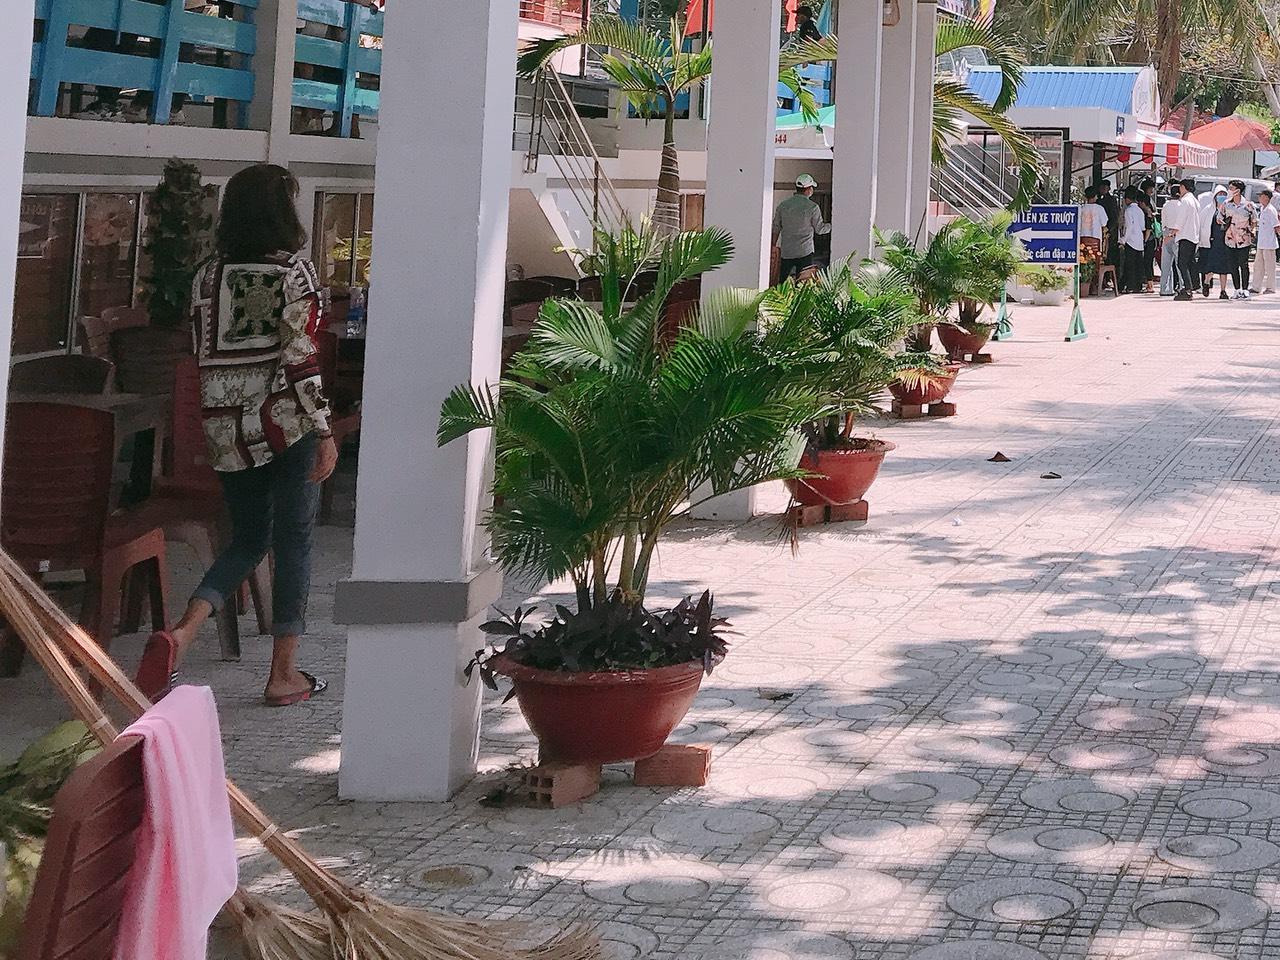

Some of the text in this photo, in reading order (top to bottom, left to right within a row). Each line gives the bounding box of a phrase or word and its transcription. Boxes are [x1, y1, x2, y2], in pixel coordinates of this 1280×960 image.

[1039, 212, 1049, 224] XE
[1050, 211, 1075, 225] TRƯỢT
[1035, 246, 1051, 259] cấm
[1067, 250, 1076, 259] xe
